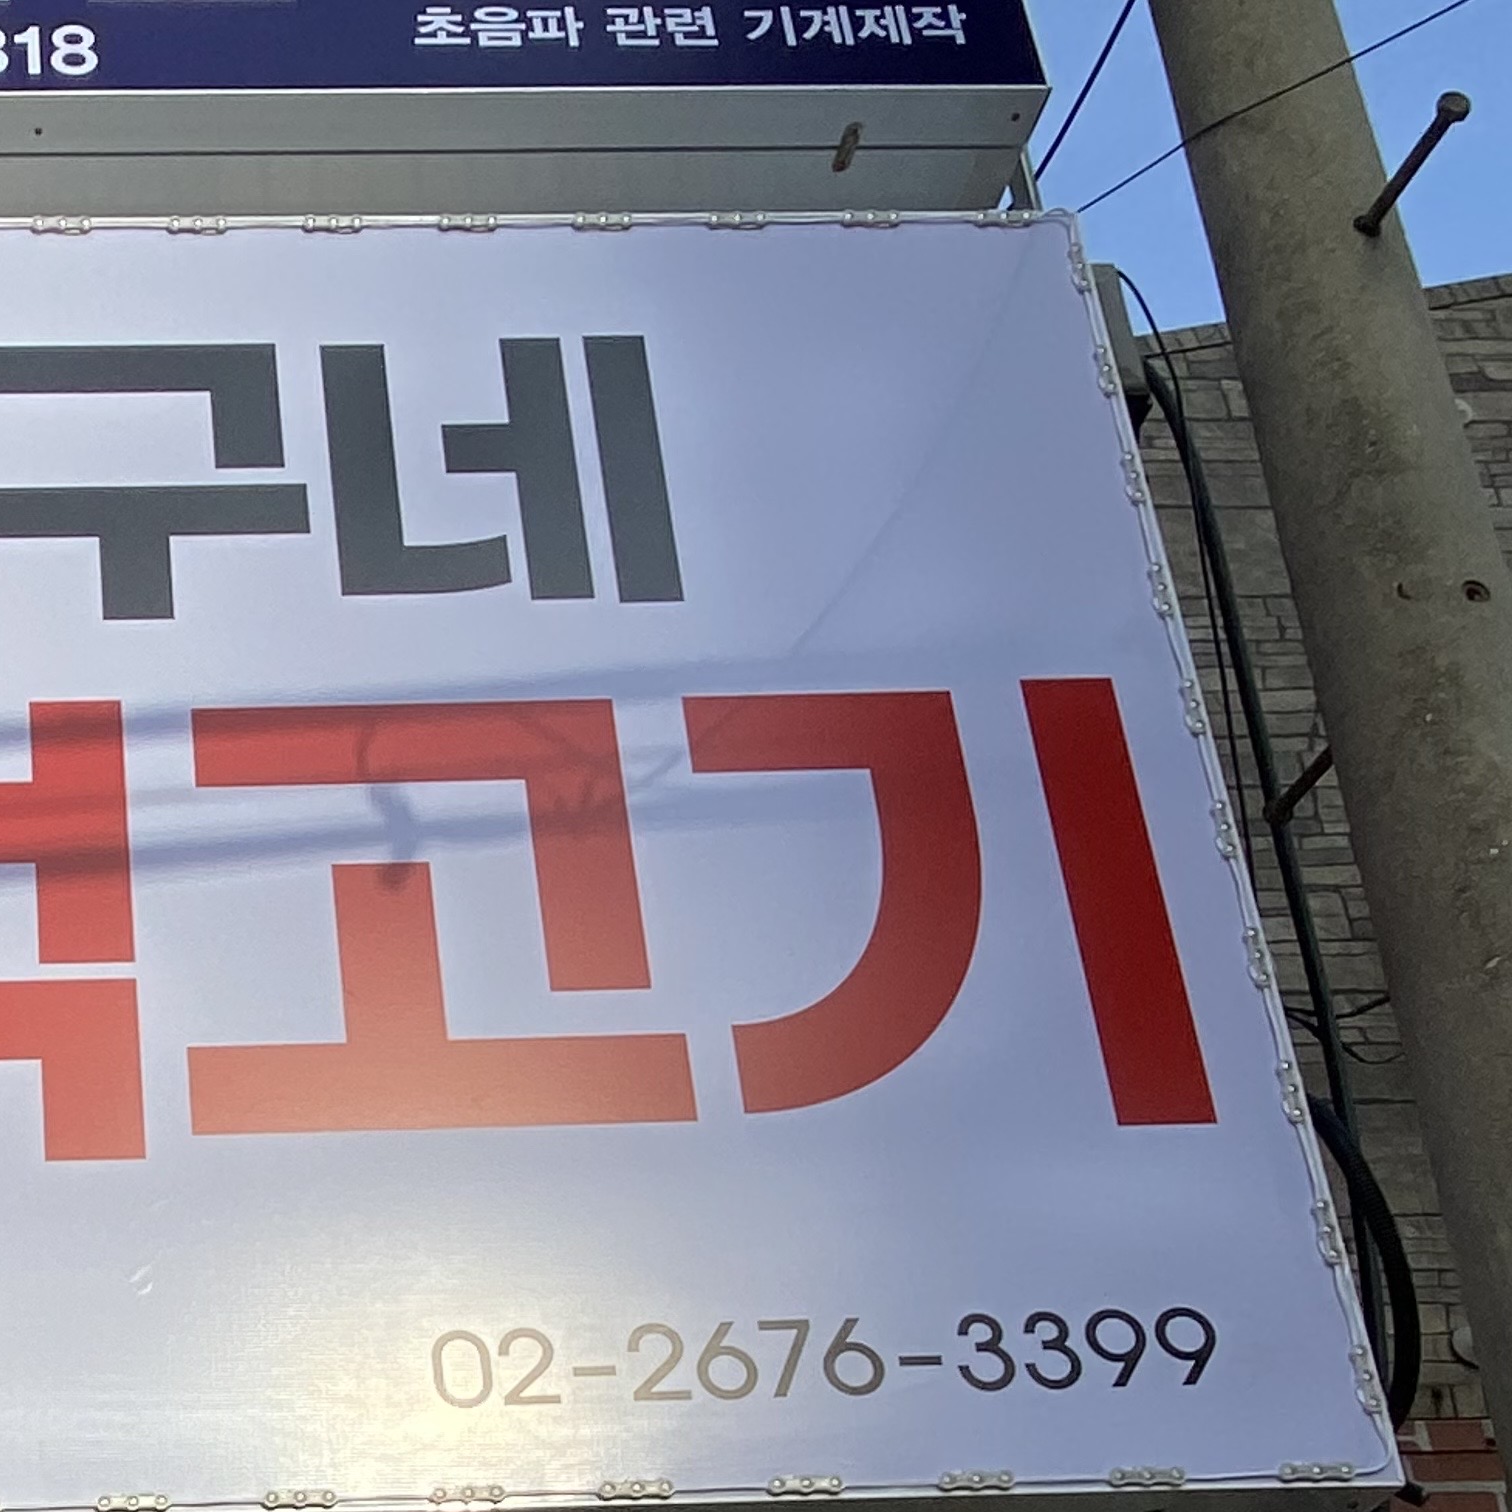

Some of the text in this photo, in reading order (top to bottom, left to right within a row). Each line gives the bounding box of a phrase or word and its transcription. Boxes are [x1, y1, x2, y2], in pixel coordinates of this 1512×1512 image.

[414, 3, 968, 48] 초음파 관련 기계제작
[430, 1305, 1217, 1409] 02-2676-3399
